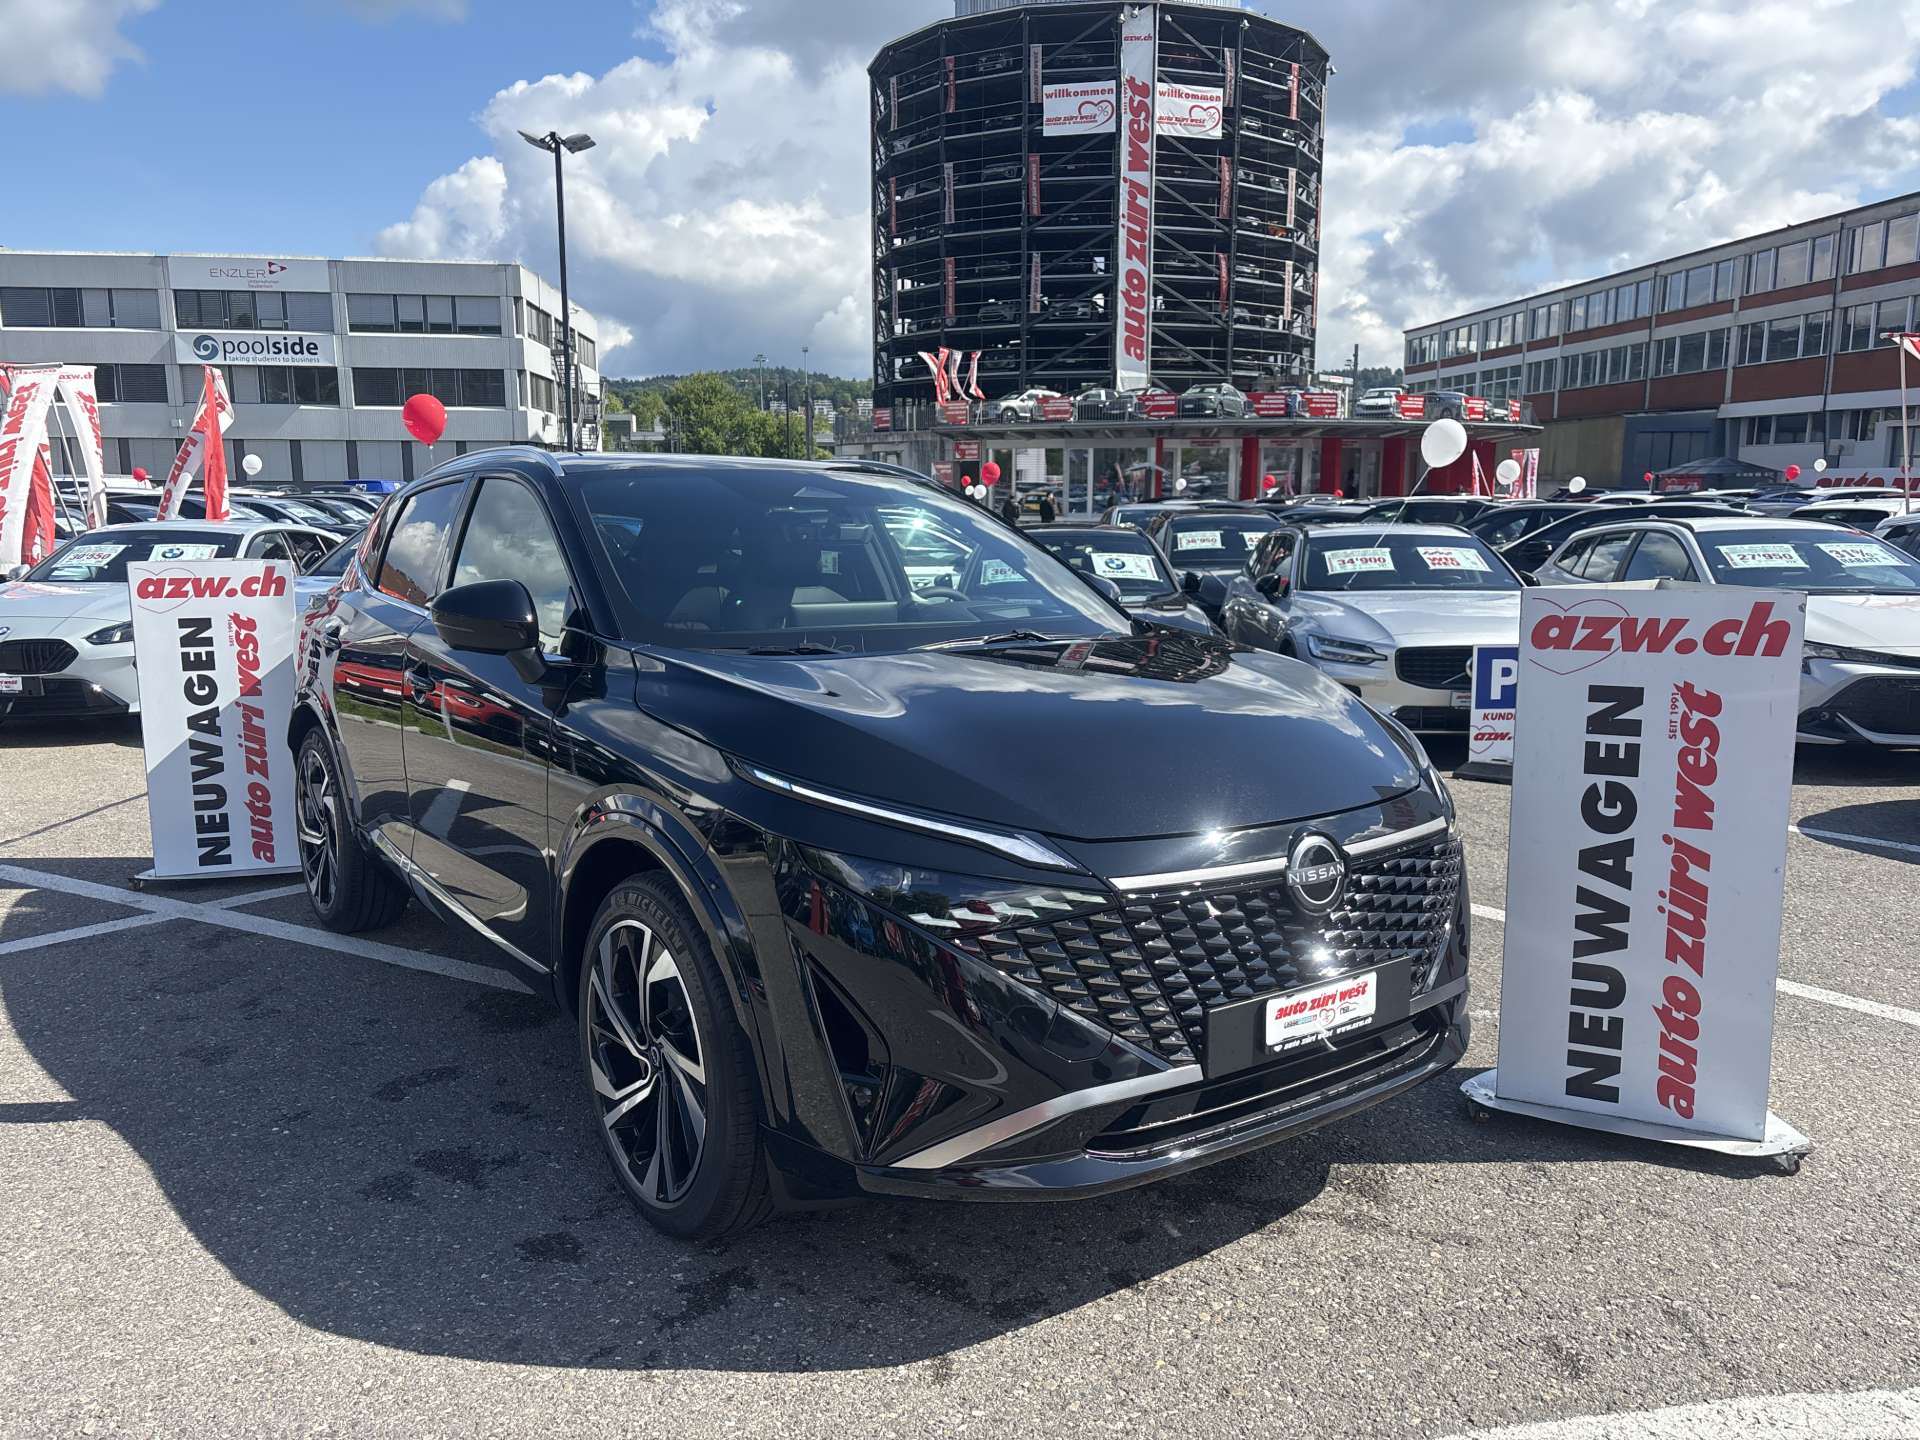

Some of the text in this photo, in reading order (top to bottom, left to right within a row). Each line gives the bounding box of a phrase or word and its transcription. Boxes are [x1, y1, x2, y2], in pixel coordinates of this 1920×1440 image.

[1044, 87, 1114, 99] willkommen
[1158, 88, 1221, 102] willkommen
[1121, 75, 1151, 362] auto züri west
[209, 267, 266, 279] ENZLER
[223, 336, 319, 361] poolside
[229, 355, 250, 363] taking
[251, 355, 281, 363] students
[1337, 556, 1387, 566] 34'900
[136, 566, 287, 600] azw.ch
[1531, 601, 1791, 657] azw.ch
[1490, 659, 1518, 701] P
[1482, 712, 1516, 721] KUND
[1668, 691, 1680, 740] SEIT 1991
[177, 617, 232, 867] NEUWAGEN
[227, 611, 276, 864] auto züri west
[1288, 862, 1345, 884] NISSAN
[1565, 684, 1644, 1104] NEUWAGEN
[1652, 680, 1723, 1120] auto züri west
[626, 892, 684, 955] MICHELIN
[1275, 999, 1308, 1020] auto
[1308, 989, 1338, 1011] züri
[1339, 981, 1369, 1002] west
